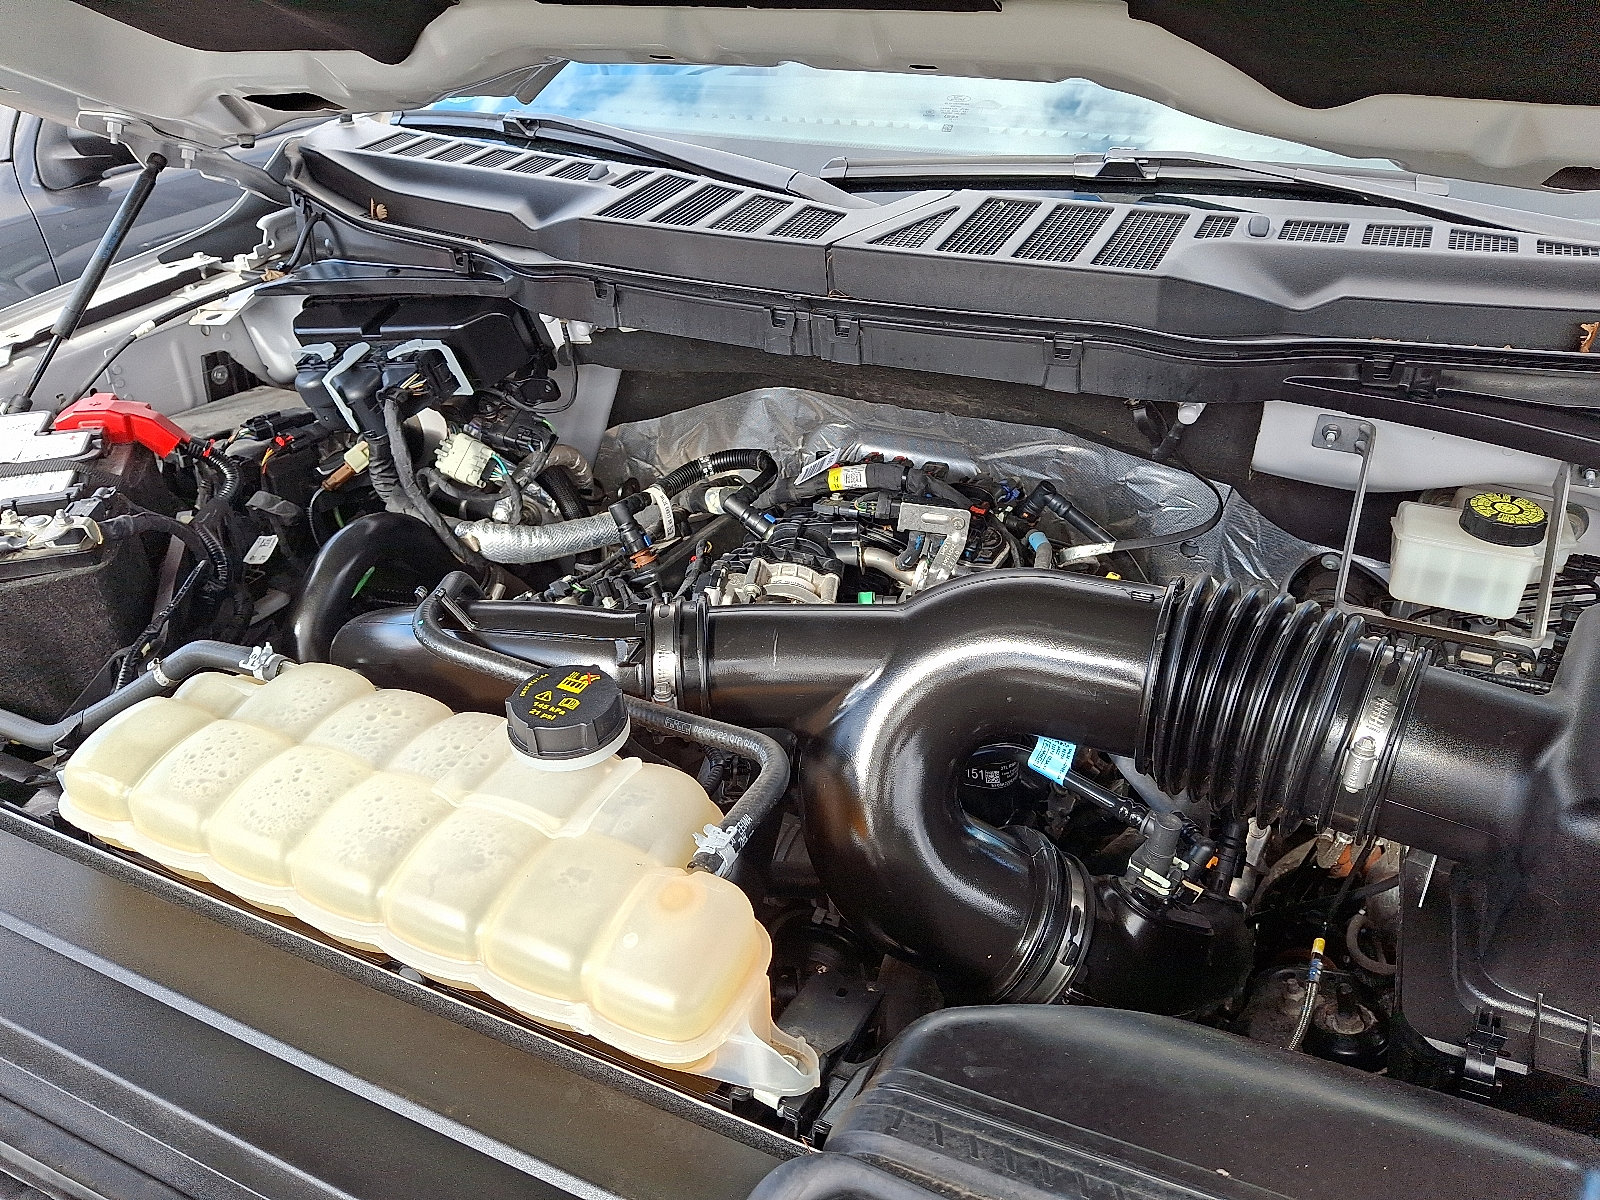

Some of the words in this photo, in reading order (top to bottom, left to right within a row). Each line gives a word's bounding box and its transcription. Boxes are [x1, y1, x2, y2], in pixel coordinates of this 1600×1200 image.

[532, 701, 550, 710] 145
[548, 706, 566, 716] kPa
[540, 713, 557, 721] psi
